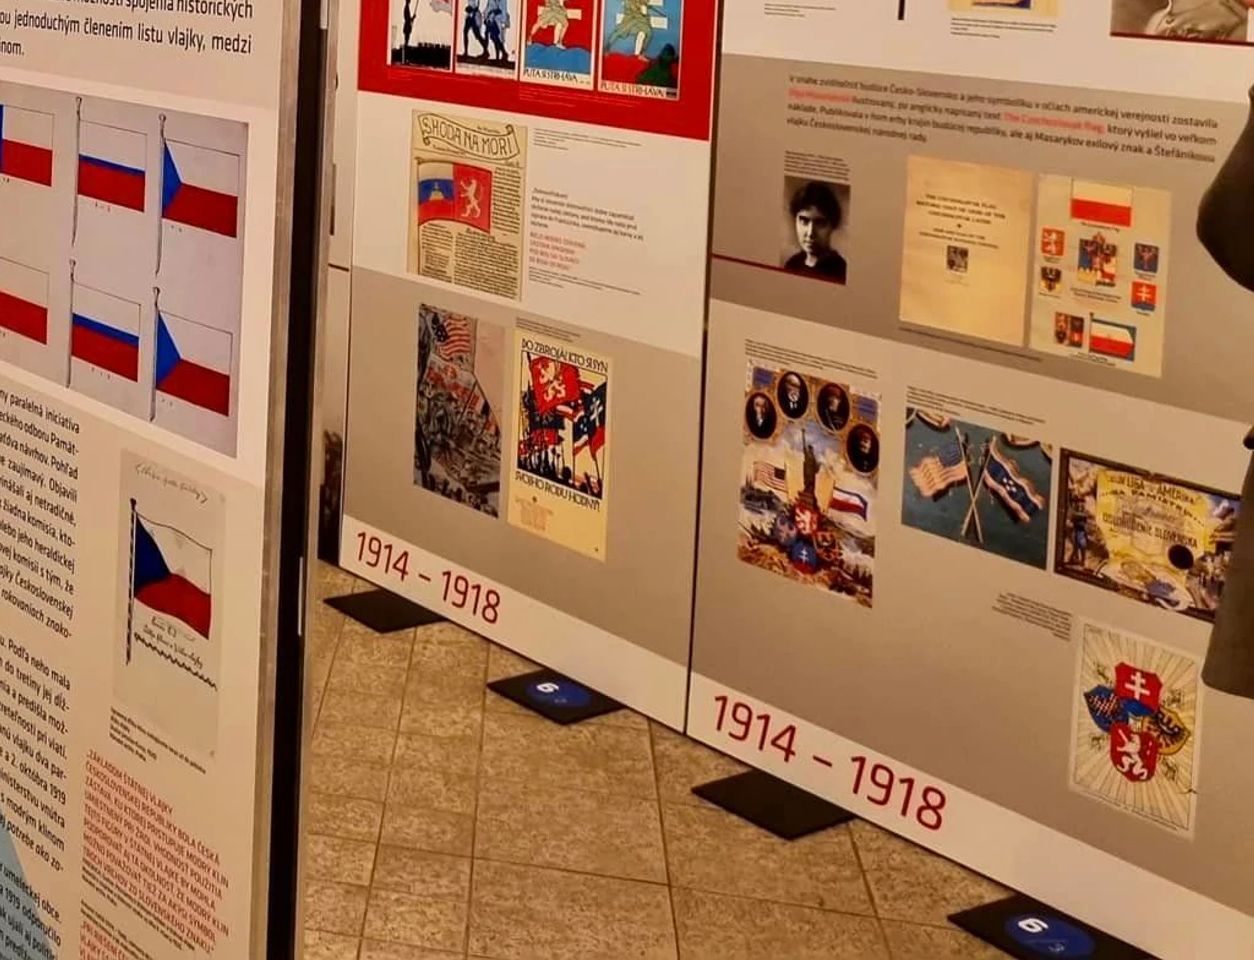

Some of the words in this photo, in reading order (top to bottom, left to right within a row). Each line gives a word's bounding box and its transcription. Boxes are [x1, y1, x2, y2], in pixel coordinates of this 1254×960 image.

[14, 9, 79, 36] jednoduchým
[138, 24, 163, 43] listu
[168, 27, 205, 52] vlajky,
[212, 34, 251, 54] medzi
[422, 119, 461, 141] SHODA
[464, 134, 478, 150] NA
[357, 532, 408, 581] 1914
[442, 570, 500, 624] 1918
[714, 694, 797, 763] 1914
[851, 755, 946, 831] 1918
